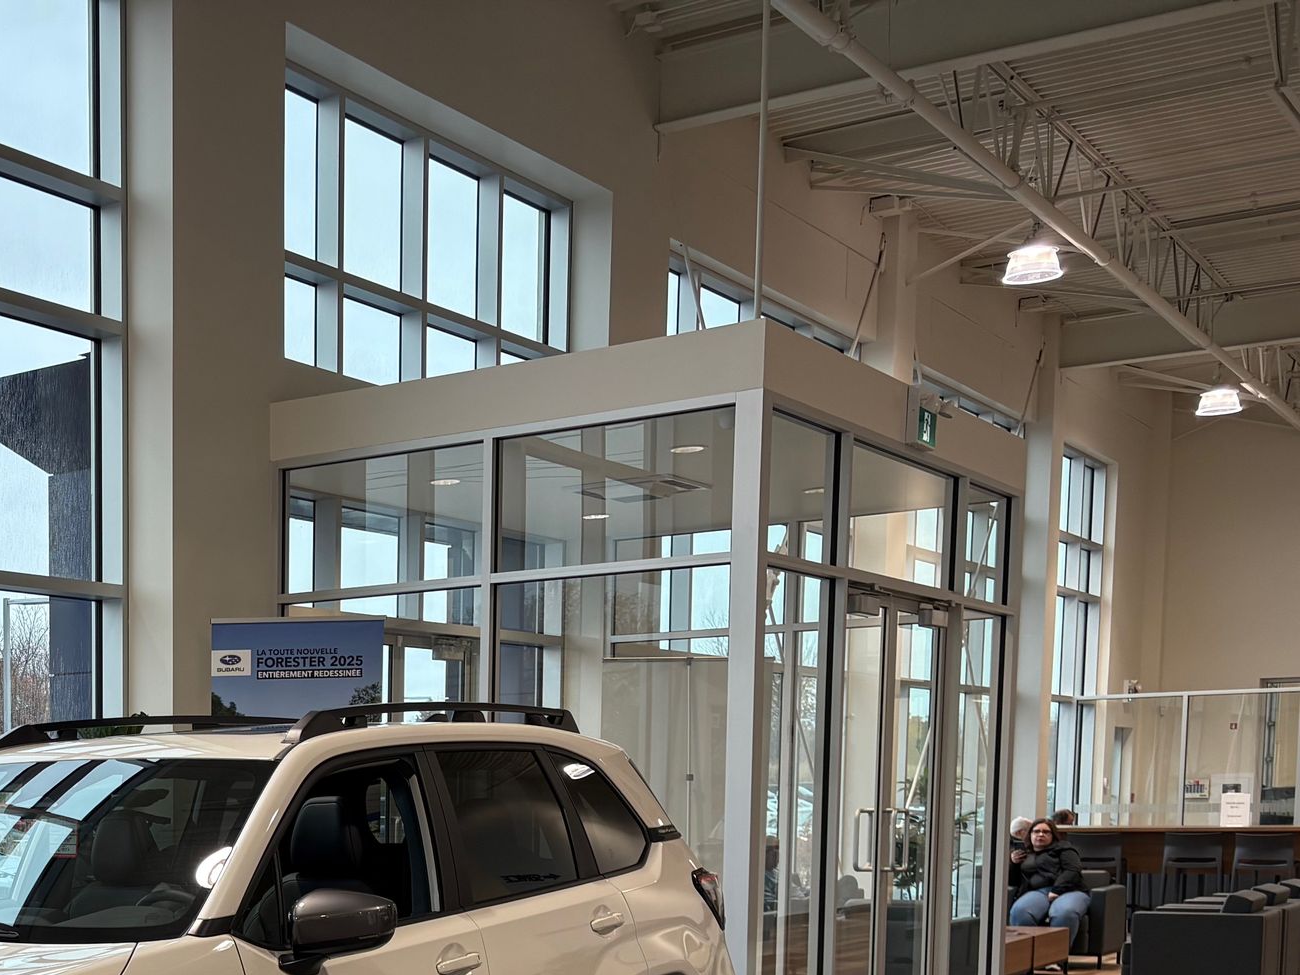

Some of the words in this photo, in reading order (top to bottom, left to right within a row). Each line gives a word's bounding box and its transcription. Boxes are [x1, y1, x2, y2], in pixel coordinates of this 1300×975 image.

[296, 648, 338, 656] NOUVELLE
[256, 656, 326, 668] FORESTER
[330, 655, 364, 667] 2025
[258, 670, 312, 679] ENTIÈREMENT
[314, 669, 362, 678] REDESSINÉE
